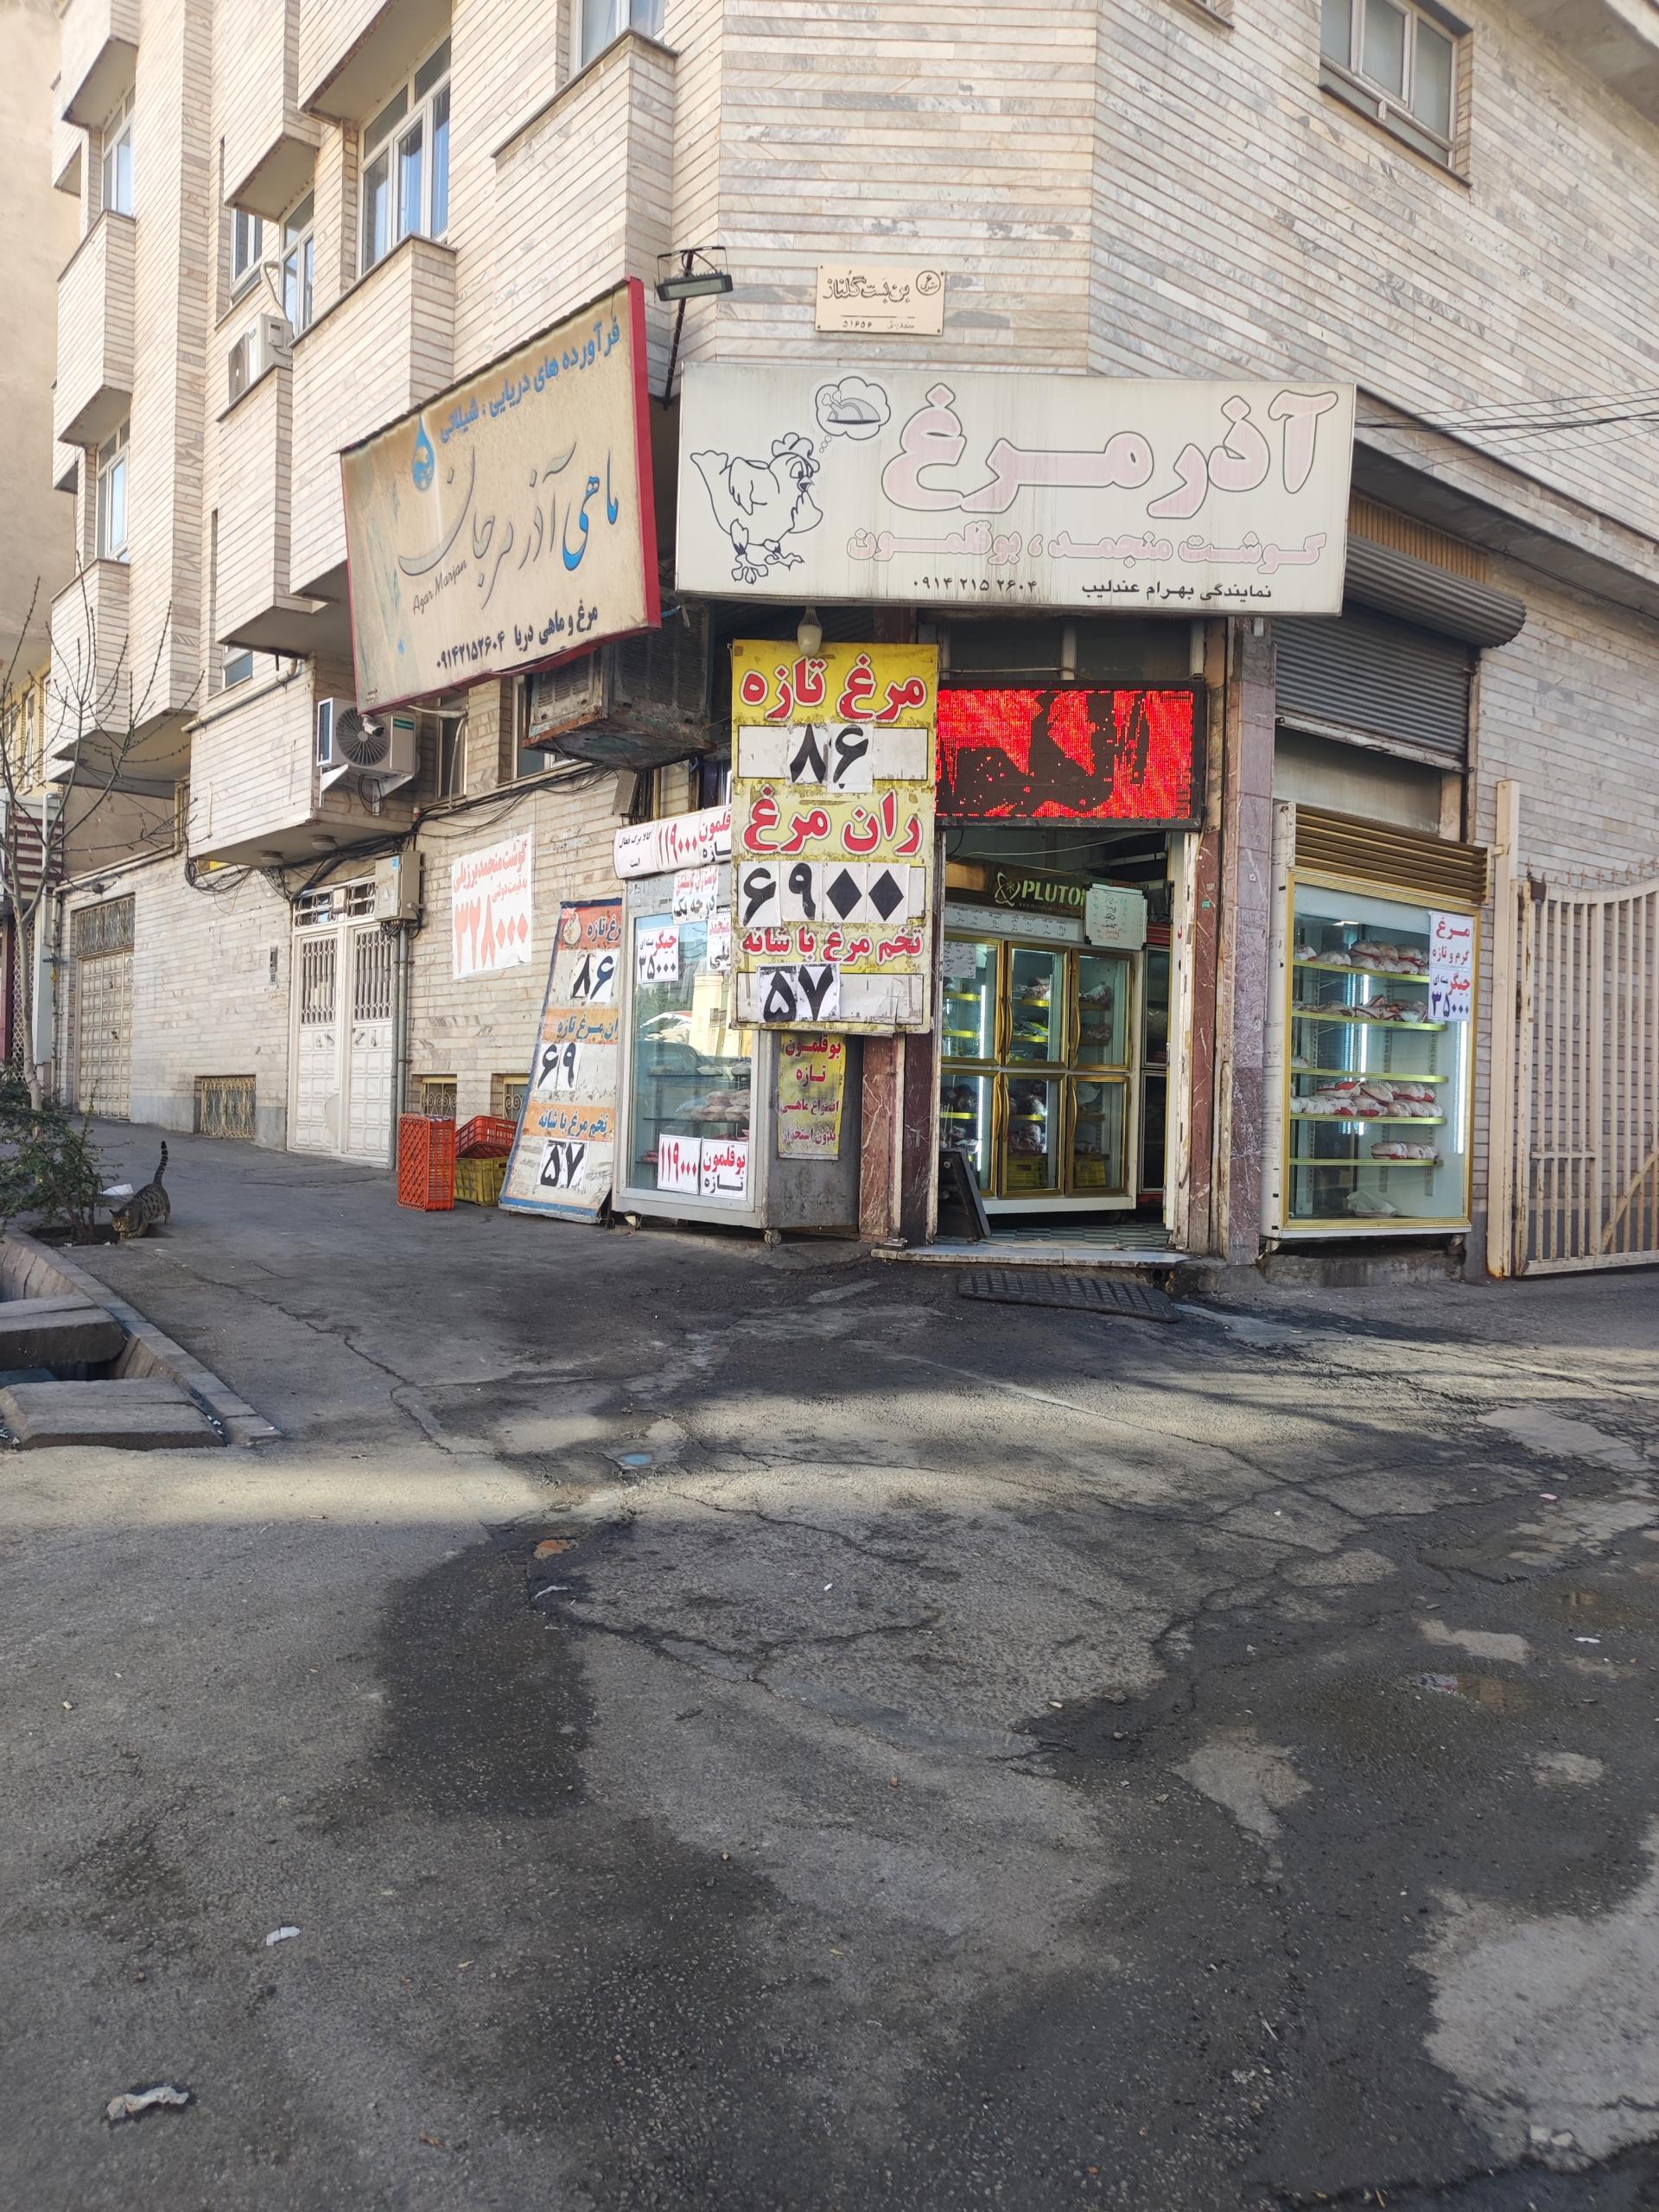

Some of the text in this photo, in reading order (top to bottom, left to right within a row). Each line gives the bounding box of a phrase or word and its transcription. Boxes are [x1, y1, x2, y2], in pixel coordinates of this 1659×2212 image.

[533, 357, 560, 393] های
[489, 373, 531, 418] دریایی
[441, 395, 480, 444] شیلاتی
[562, 447, 620, 572] ماهی
[847, 519, 1022, 566] بوقلمون
[1048, 531, 1173, 569] منجمد
[1178, 531, 1327, 575] گوشت
[412, 559, 467, 615] Azar Marjan
[1082, 580, 1141, 598] عندلیب
[1146, 581, 1195, 599] بهرام
[1199, 583, 1272, 603] نمایندگی
[538, 609, 566, 645] ماهی
[567, 613, 575, 637] و
[575, 599, 599, 633] مرغ
[513, 623, 535, 653] دریا
[740, 652, 928, 722] مرغ تازه
[789, 723, 869, 785] ۸۶
[699, 808, 732, 842] قلمون
[743, 785, 924, 856] ران مرغ
[478, 853, 502, 880] منجمد
[503, 839, 528, 874] گوشت
[702, 840, 732, 862] ازه
[587, 913, 621, 943] رغ تازه
[652, 931, 677, 957] جیگر
[741, 925, 792, 957] شانه
[796, 925, 816, 963] با
[822, 919, 872, 963] مرغ
[1436, 917, 1471, 940] مرغ
[876, 925, 924, 965] تخم
[1432, 945, 1447, 962] تازه
[1448, 952, 1453, 964] و
[572, 953, 614, 1001] ۸۶
[1447, 972, 1471, 996] جیگر
[762, 964, 835, 1024] ۵۷
[557, 1015, 576, 1039] تازه
[605, 1017, 619, 1039] ان
[785, 1034, 842, 1060] بوقلمون
[537, 1042, 576, 1090] ۶۹
[796, 1064, 827, 1087] تازه
[781, 1097, 839, 1116] انواع ماهی
[538, 1109, 609, 1137] تخم مرغ با شانه
[814, 1130, 836, 1147] بدون
[540, 1141, 586, 1189] ۵۷
[702, 1144, 746, 1175] بوقلمون
[704, 1173, 744, 1194] تازه
